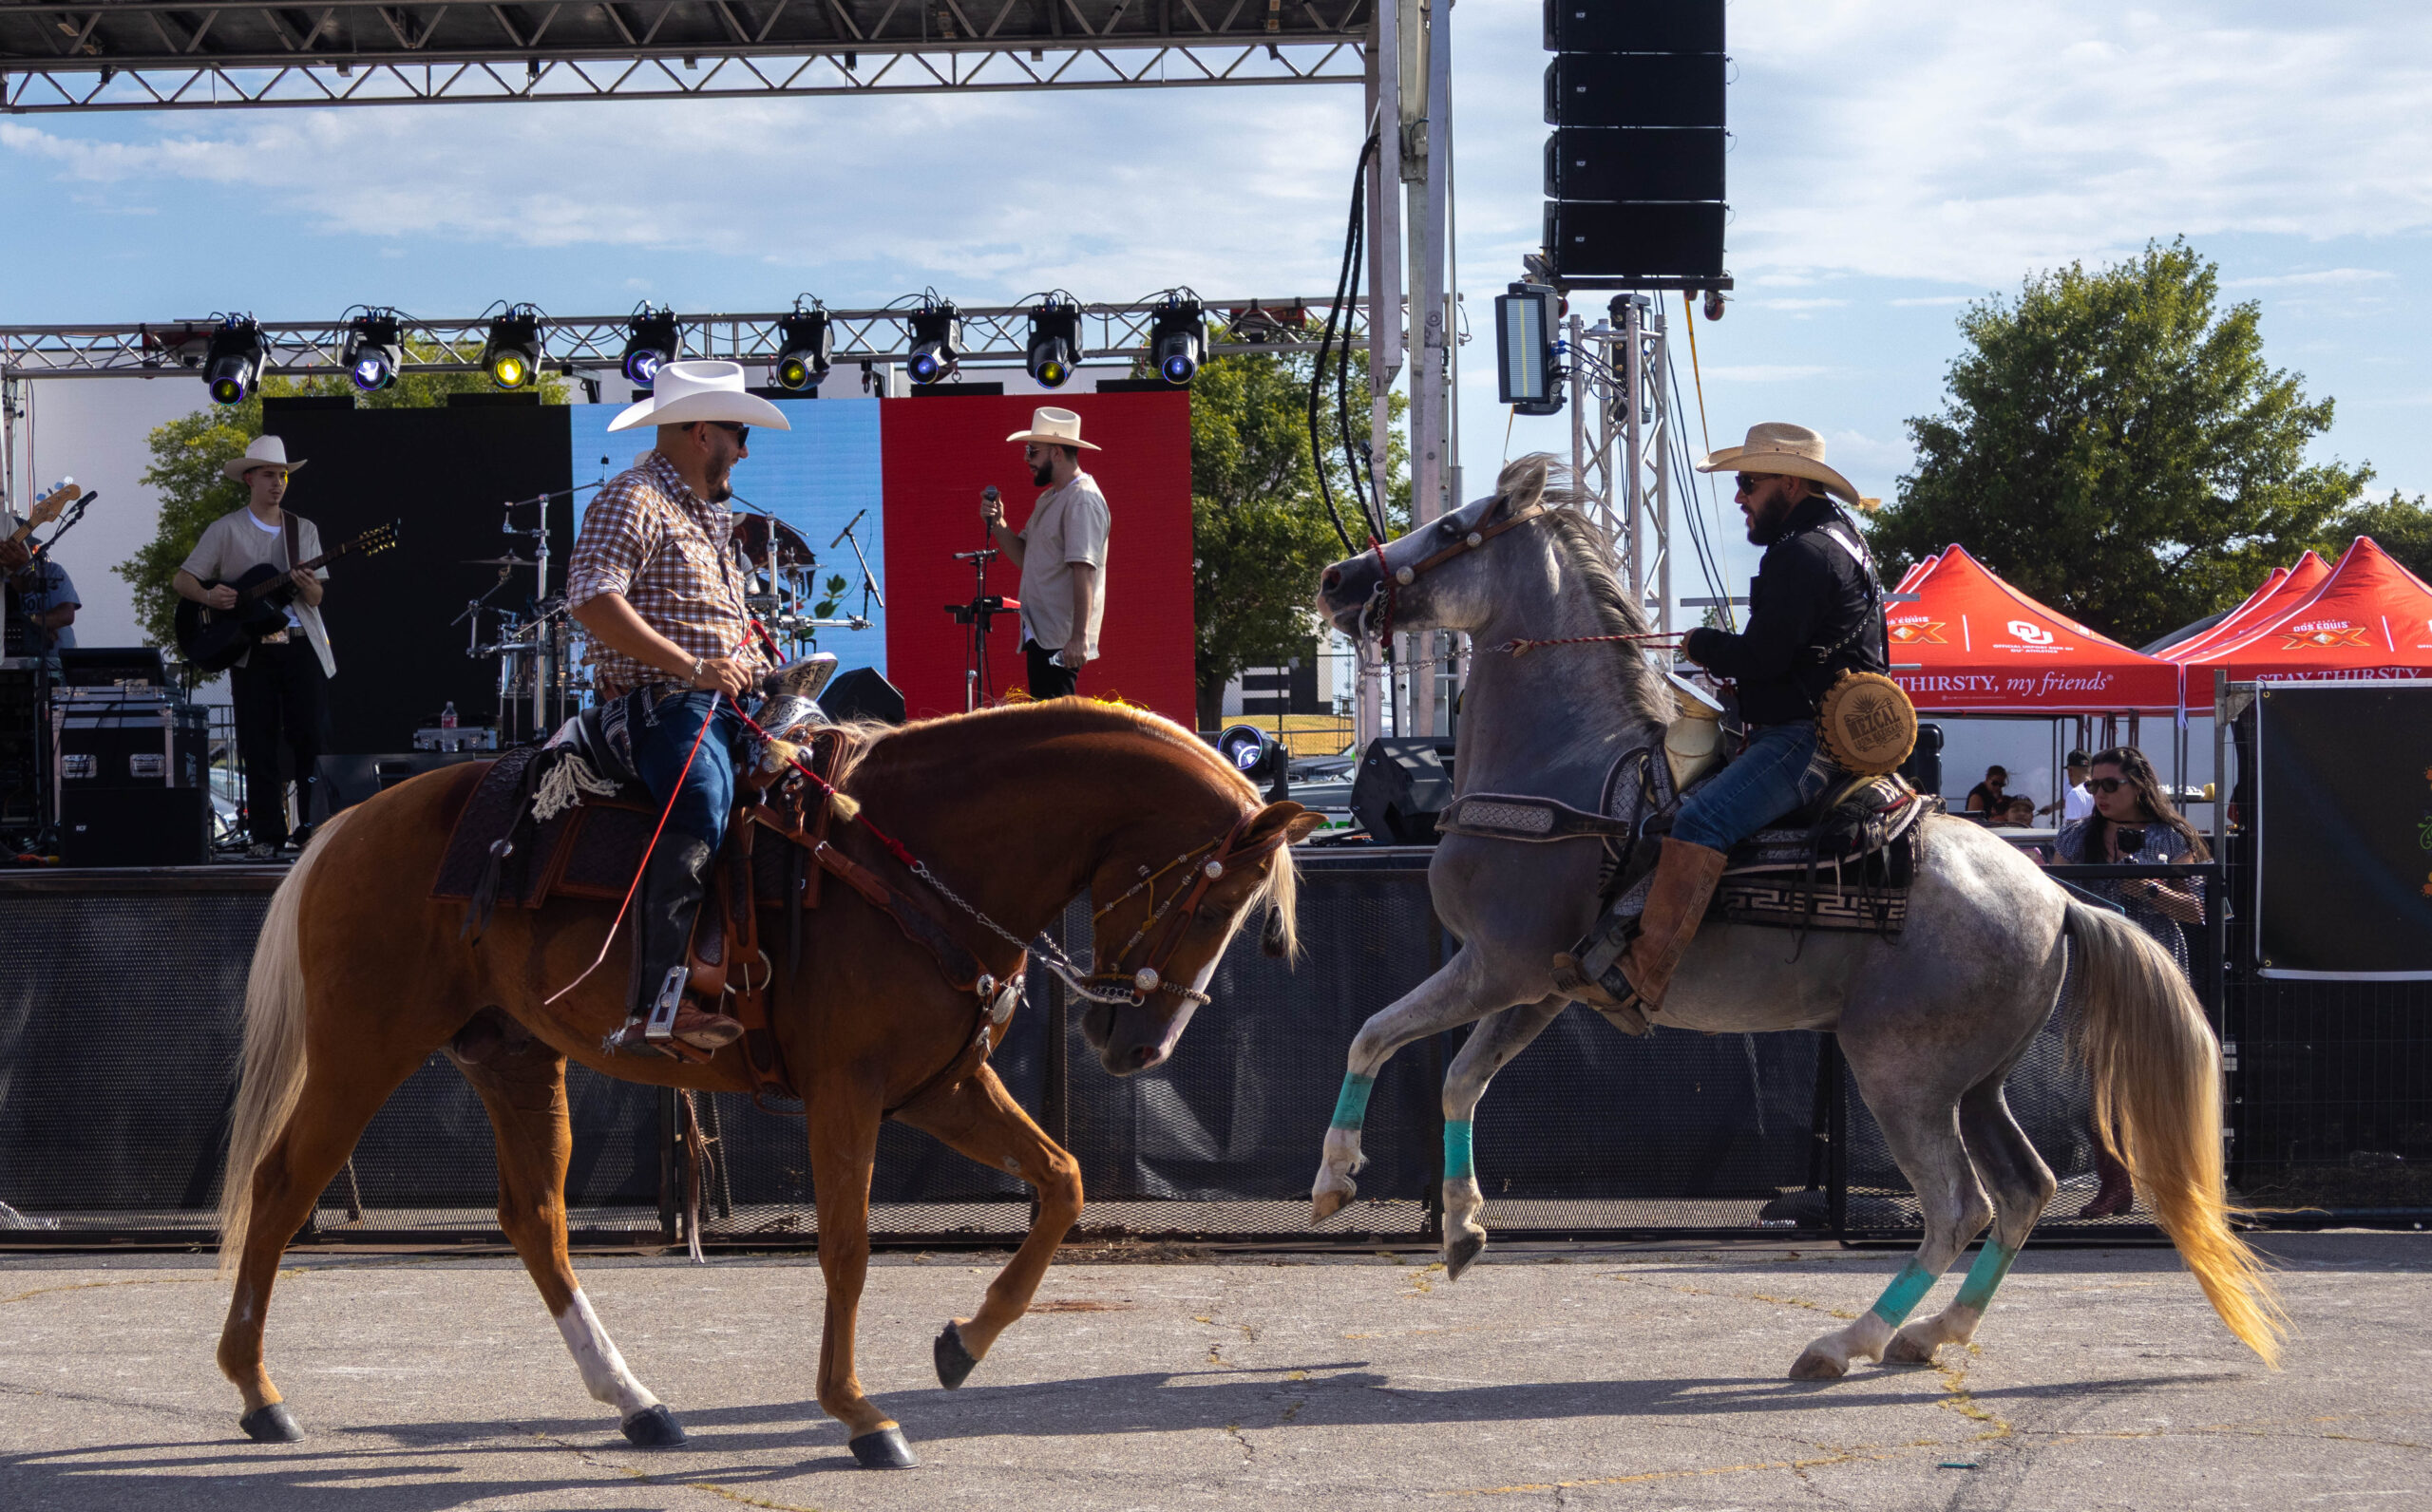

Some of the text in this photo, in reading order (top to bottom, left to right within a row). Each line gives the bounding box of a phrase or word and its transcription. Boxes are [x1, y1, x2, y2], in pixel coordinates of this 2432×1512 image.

[2006, 619, 2054, 645] OU
[2293, 624, 2314, 633] DOS
[2316, 621, 2348, 631] EQUIS
[1894, 675, 1999, 692] THIRSTY,
[2006, 678, 2036, 697] my
[1846, 704, 1901, 740] MEZCAL
